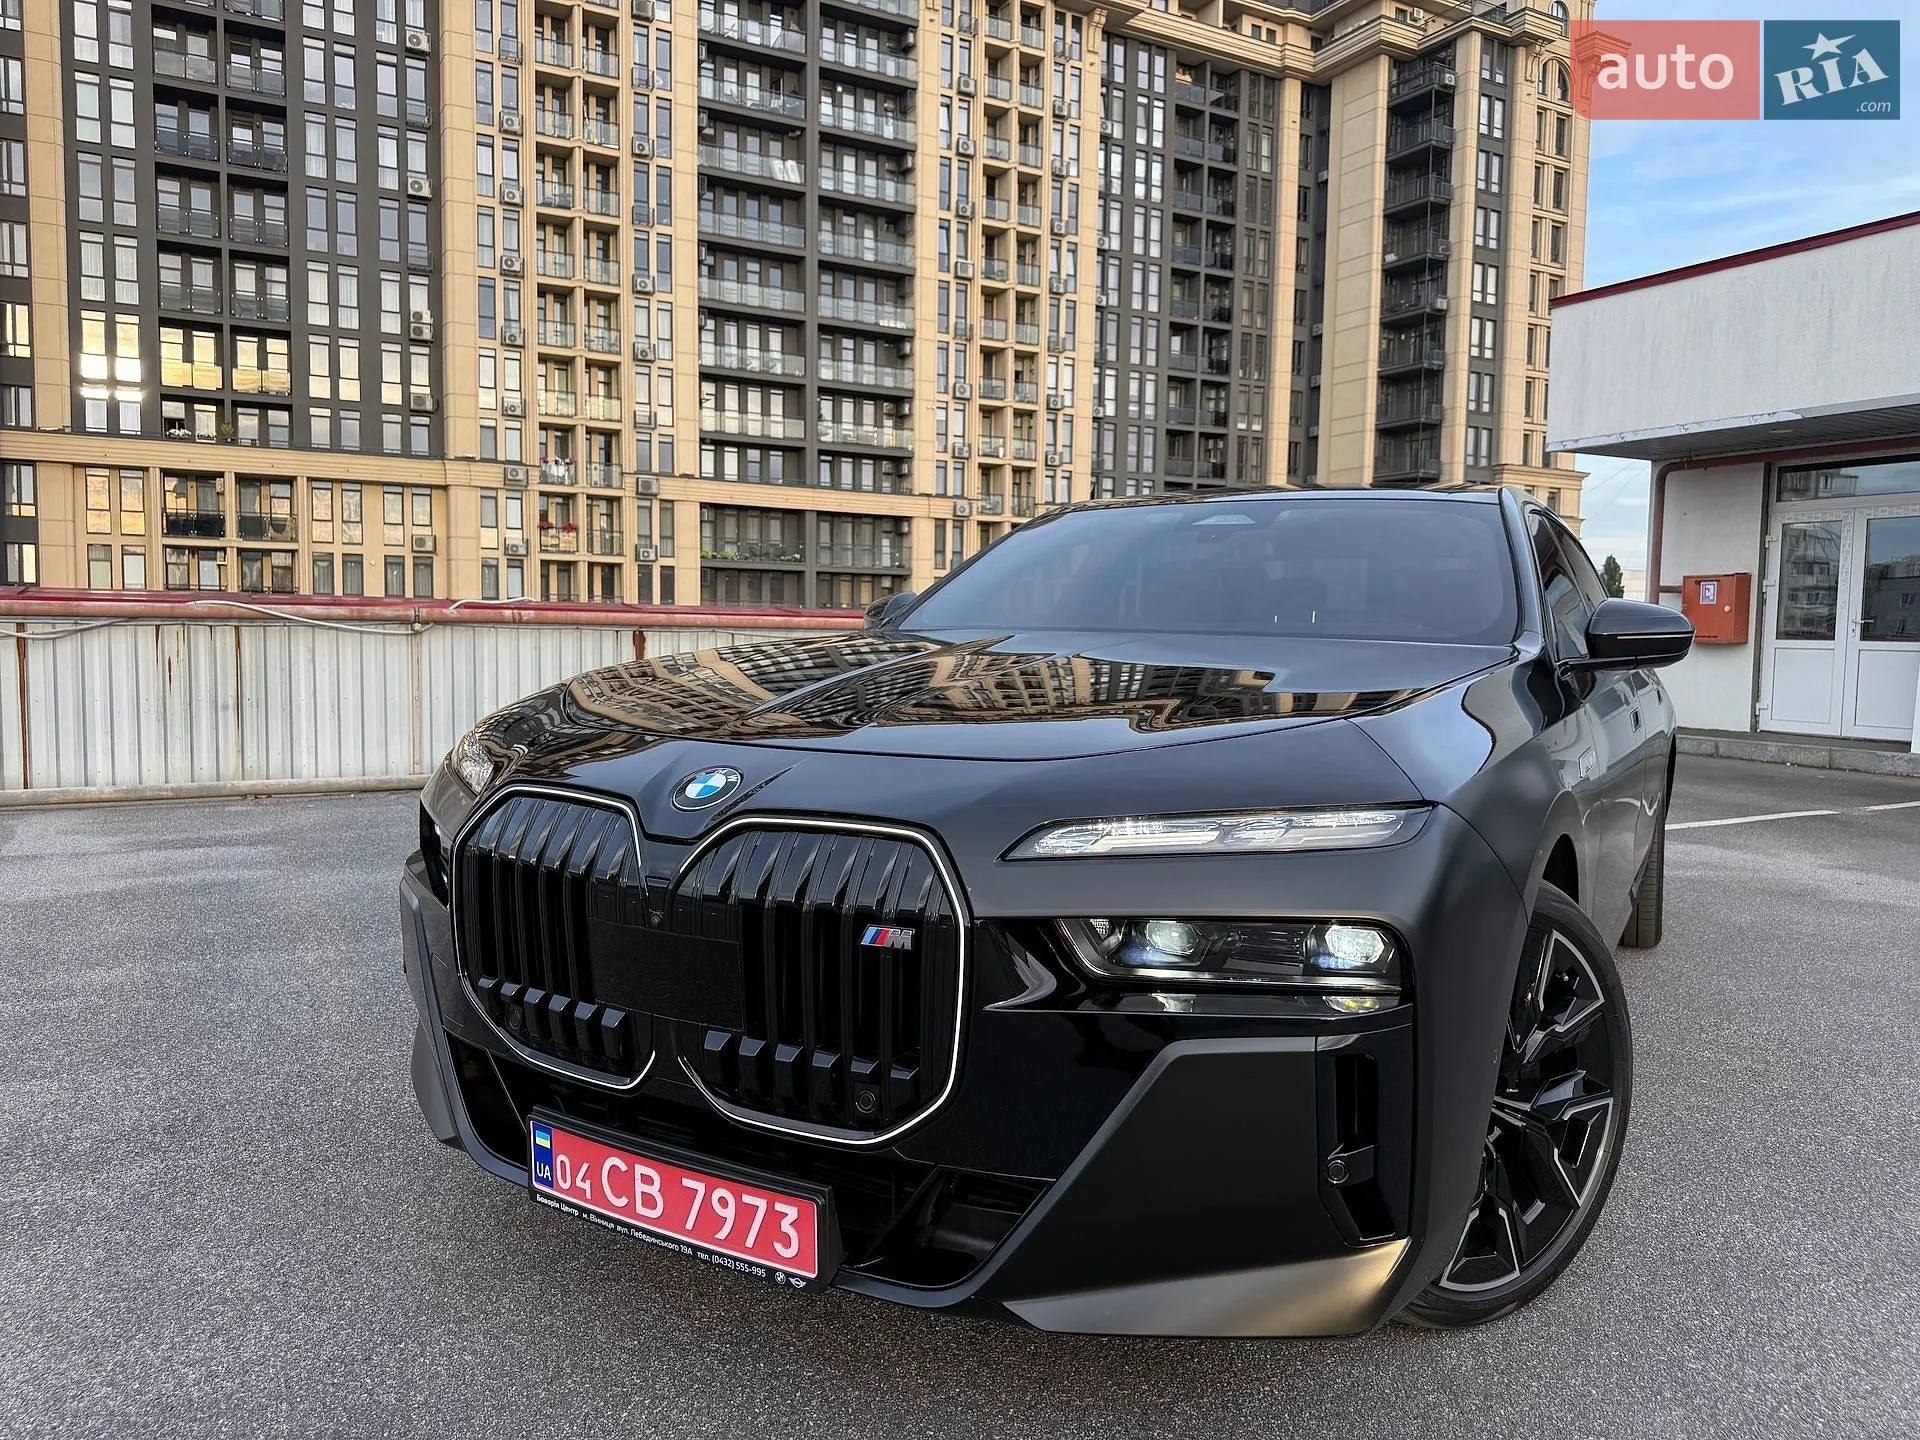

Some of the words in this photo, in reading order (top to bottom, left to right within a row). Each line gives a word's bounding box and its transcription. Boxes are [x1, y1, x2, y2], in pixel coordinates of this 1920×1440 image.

[536, 1160, 552, 1181] UA
[556, 1153, 593, 1200] 04
[601, 1156, 665, 1220] CB
[680, 1177, 800, 1259] 7973
[589, 1213, 615, 1229] Вінниця
[711, 1254, 735, 1270] (0432)
[735, 1261, 766, 1278] 555-995
